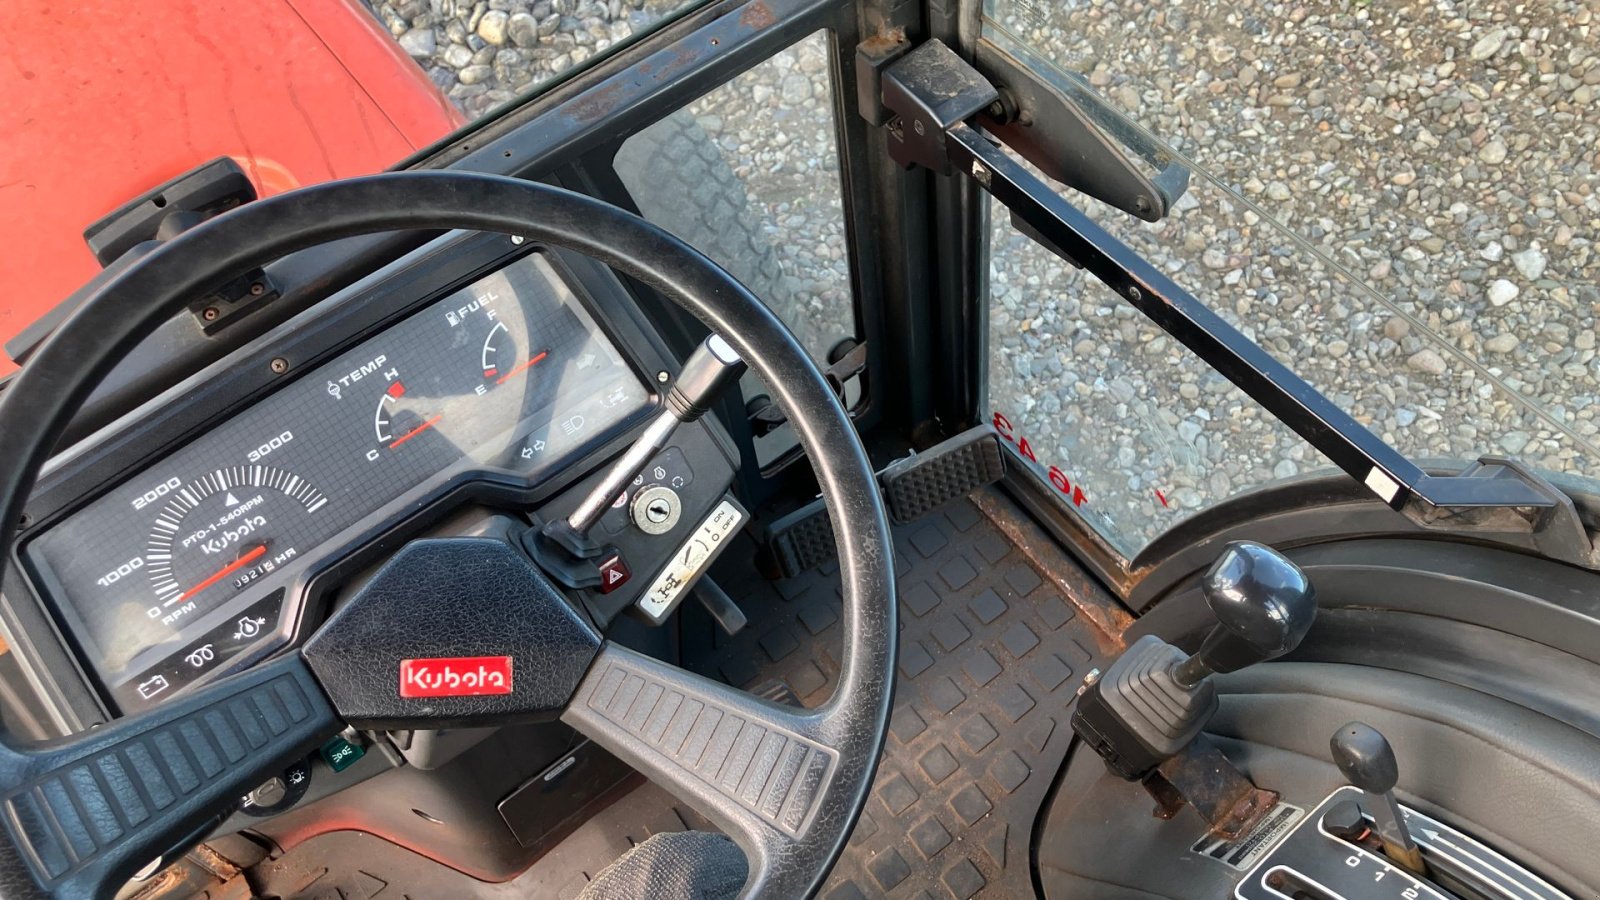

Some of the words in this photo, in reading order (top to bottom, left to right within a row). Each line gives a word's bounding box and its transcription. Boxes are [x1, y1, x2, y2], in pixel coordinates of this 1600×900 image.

[458, 293, 499, 319] FUEL
[487, 309, 498, 321] F
[338, 354, 387, 388] TEMP
[385, 367, 399, 381] H
[475, 384, 487, 396] E
[247, 431, 293, 462] 3000
[366, 449, 379, 462] C
[131, 477, 181, 510] 2000
[714, 511, 725, 523] ON
[722, 515, 735, 531] OFF
[201, 515, 267, 554] Kubota
[274, 547, 297, 564] HR
[97, 557, 144, 587] 1000
[147, 606, 161, 619] 0
[162, 602, 196, 626] RPM
[407, 665, 504, 689] Kubota
[1345, 856, 1361, 867] 0
[1375, 872, 1386, 882] 1
[1401, 887, 1419, 900] 2
